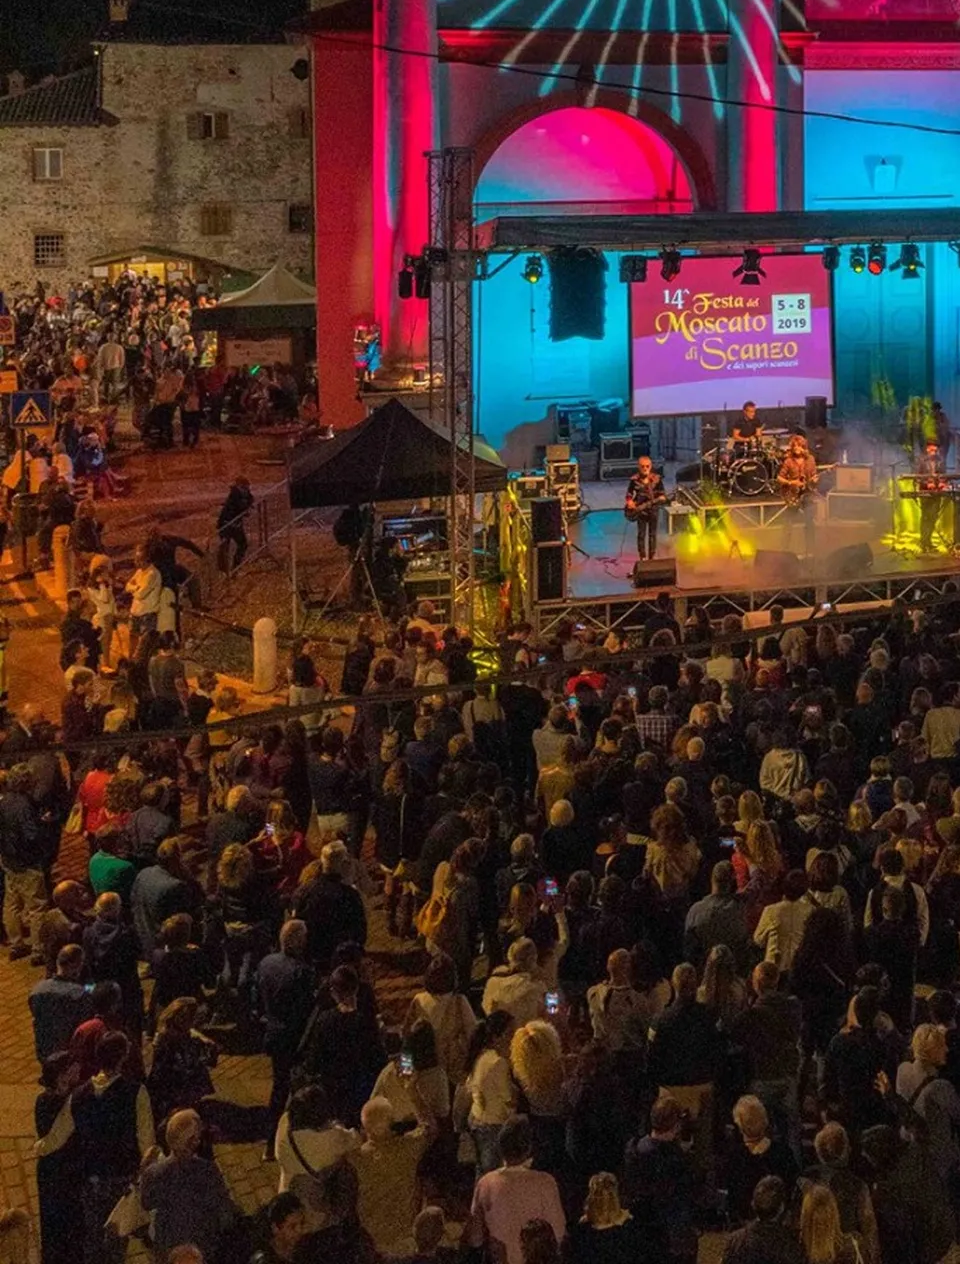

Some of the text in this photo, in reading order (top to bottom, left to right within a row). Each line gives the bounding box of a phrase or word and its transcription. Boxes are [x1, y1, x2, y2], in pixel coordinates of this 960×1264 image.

[692, 292, 744, 315] Festa
[777, 300, 785, 311] 5
[797, 298, 806, 310] 8
[655, 310, 767, 345] Moscato
[777, 318, 807, 329] 2019
[685, 337, 798, 370] di Scanzo
